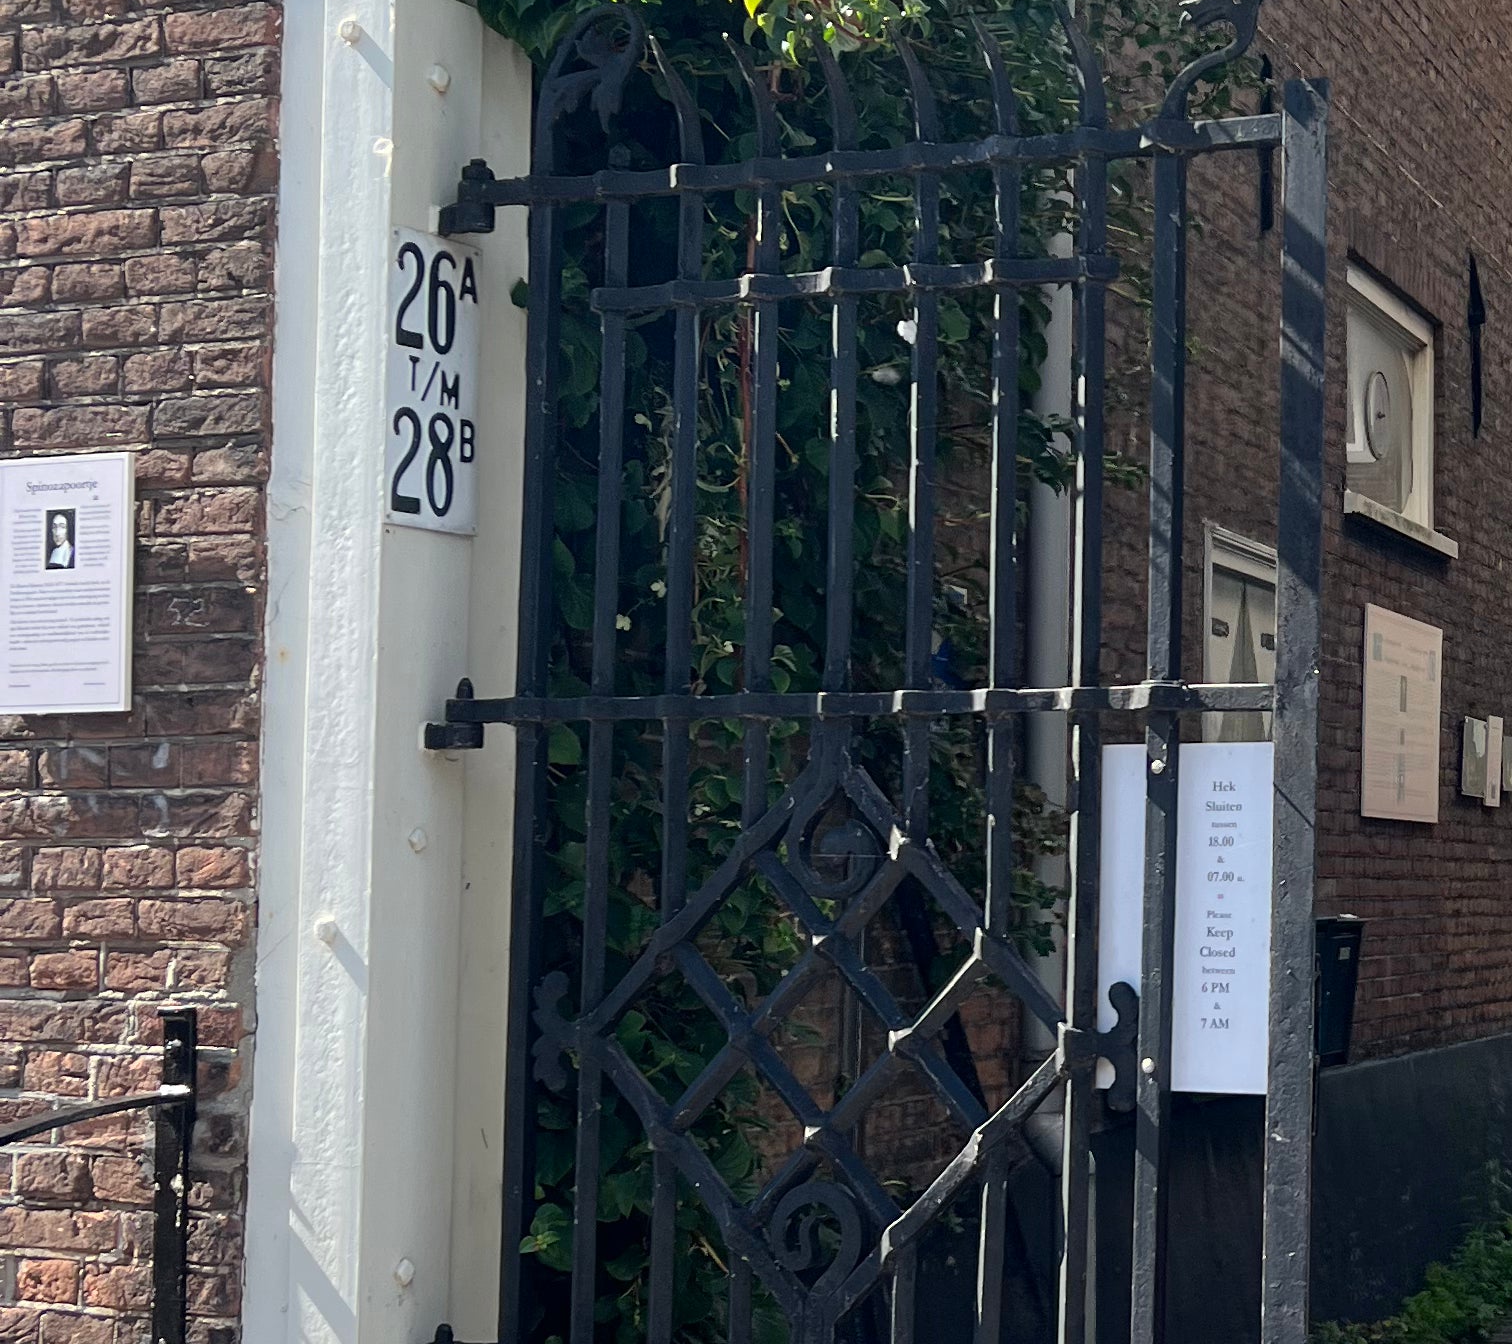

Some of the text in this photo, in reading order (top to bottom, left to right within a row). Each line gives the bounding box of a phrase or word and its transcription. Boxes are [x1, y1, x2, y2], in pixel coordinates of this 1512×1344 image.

[409, 355, 460, 410] T/M
[1212, 781, 1236, 792] Hek
[1205, 800, 1243, 812] Sluiten
[1208, 835, 1235, 847] 18.00
[1207, 871, 1235, 882] 07.00
[1206, 926, 1234, 941] Keep
[1199, 945, 1236, 958] Closed
[1201, 982, 1230, 994] 6 PM
[1200, 1017, 1229, 1030] 7 AM
